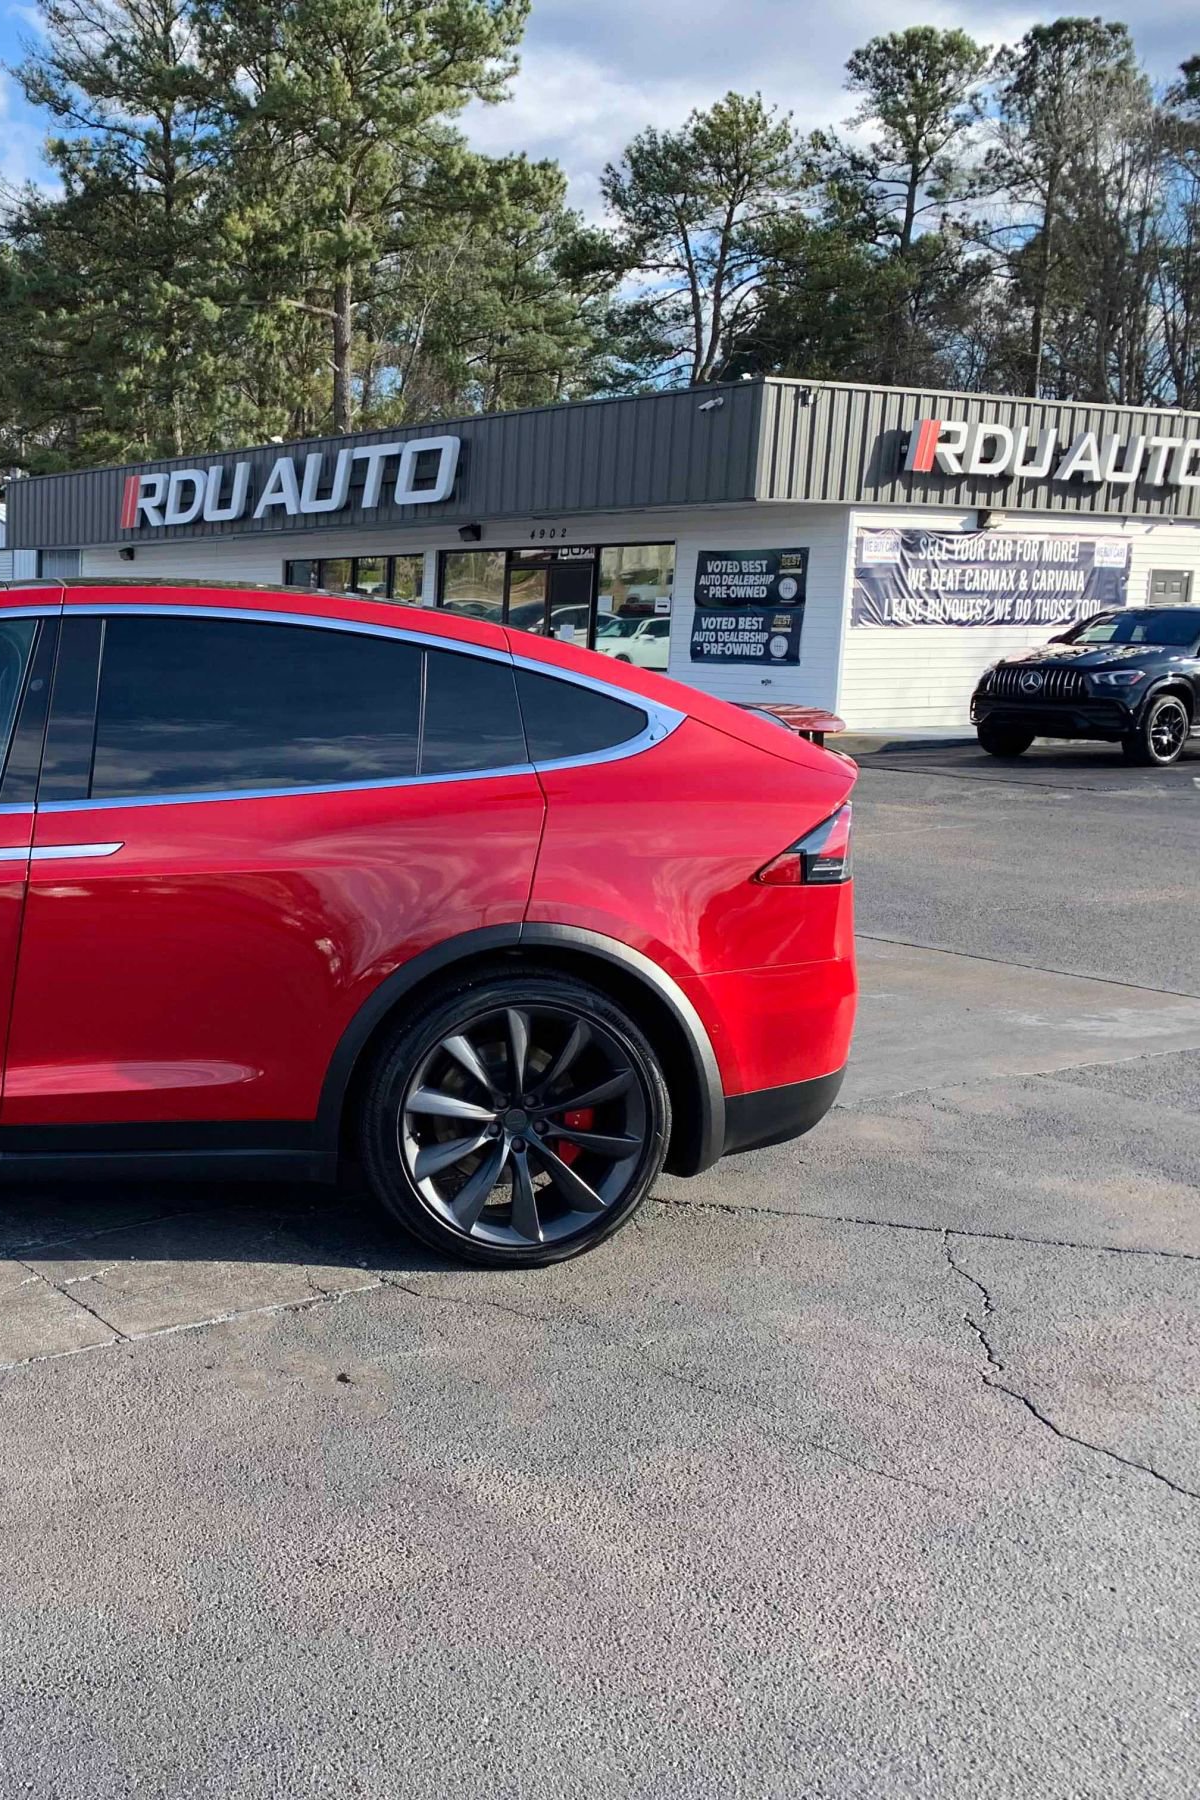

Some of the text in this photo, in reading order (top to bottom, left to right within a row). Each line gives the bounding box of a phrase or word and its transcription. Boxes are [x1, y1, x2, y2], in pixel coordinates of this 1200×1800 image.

[905, 419, 1057, 477] RDU
[120, 435, 461, 528] RDU AUTO
[530, 527, 567, 540] 4902
[918, 538, 1080, 563] SELL YOUR CAR FOR MORE!
[707, 561, 740, 573] VOTED
[741, 561, 768, 572] BEST
[699, 575, 775, 585] AUTO DEALERSHIP
[907, 568, 1085, 592] WE BEAT CARMAX & CARVANA
[709, 586, 767, 598] PRE-OWNED
[883, 598, 924, 621] LEASE
[926, 598, 991, 622] BUYOUTS?
[993, 598, 1015, 622] WE
[1014, 598, 1033, 621] DO
[1034, 598, 1074, 621] THOSE
[701, 617, 764, 630] VOTED BEST
[692, 631, 769, 643] AUTO DEALERSHIP
[703, 643, 765, 656] PRE-OWNED
